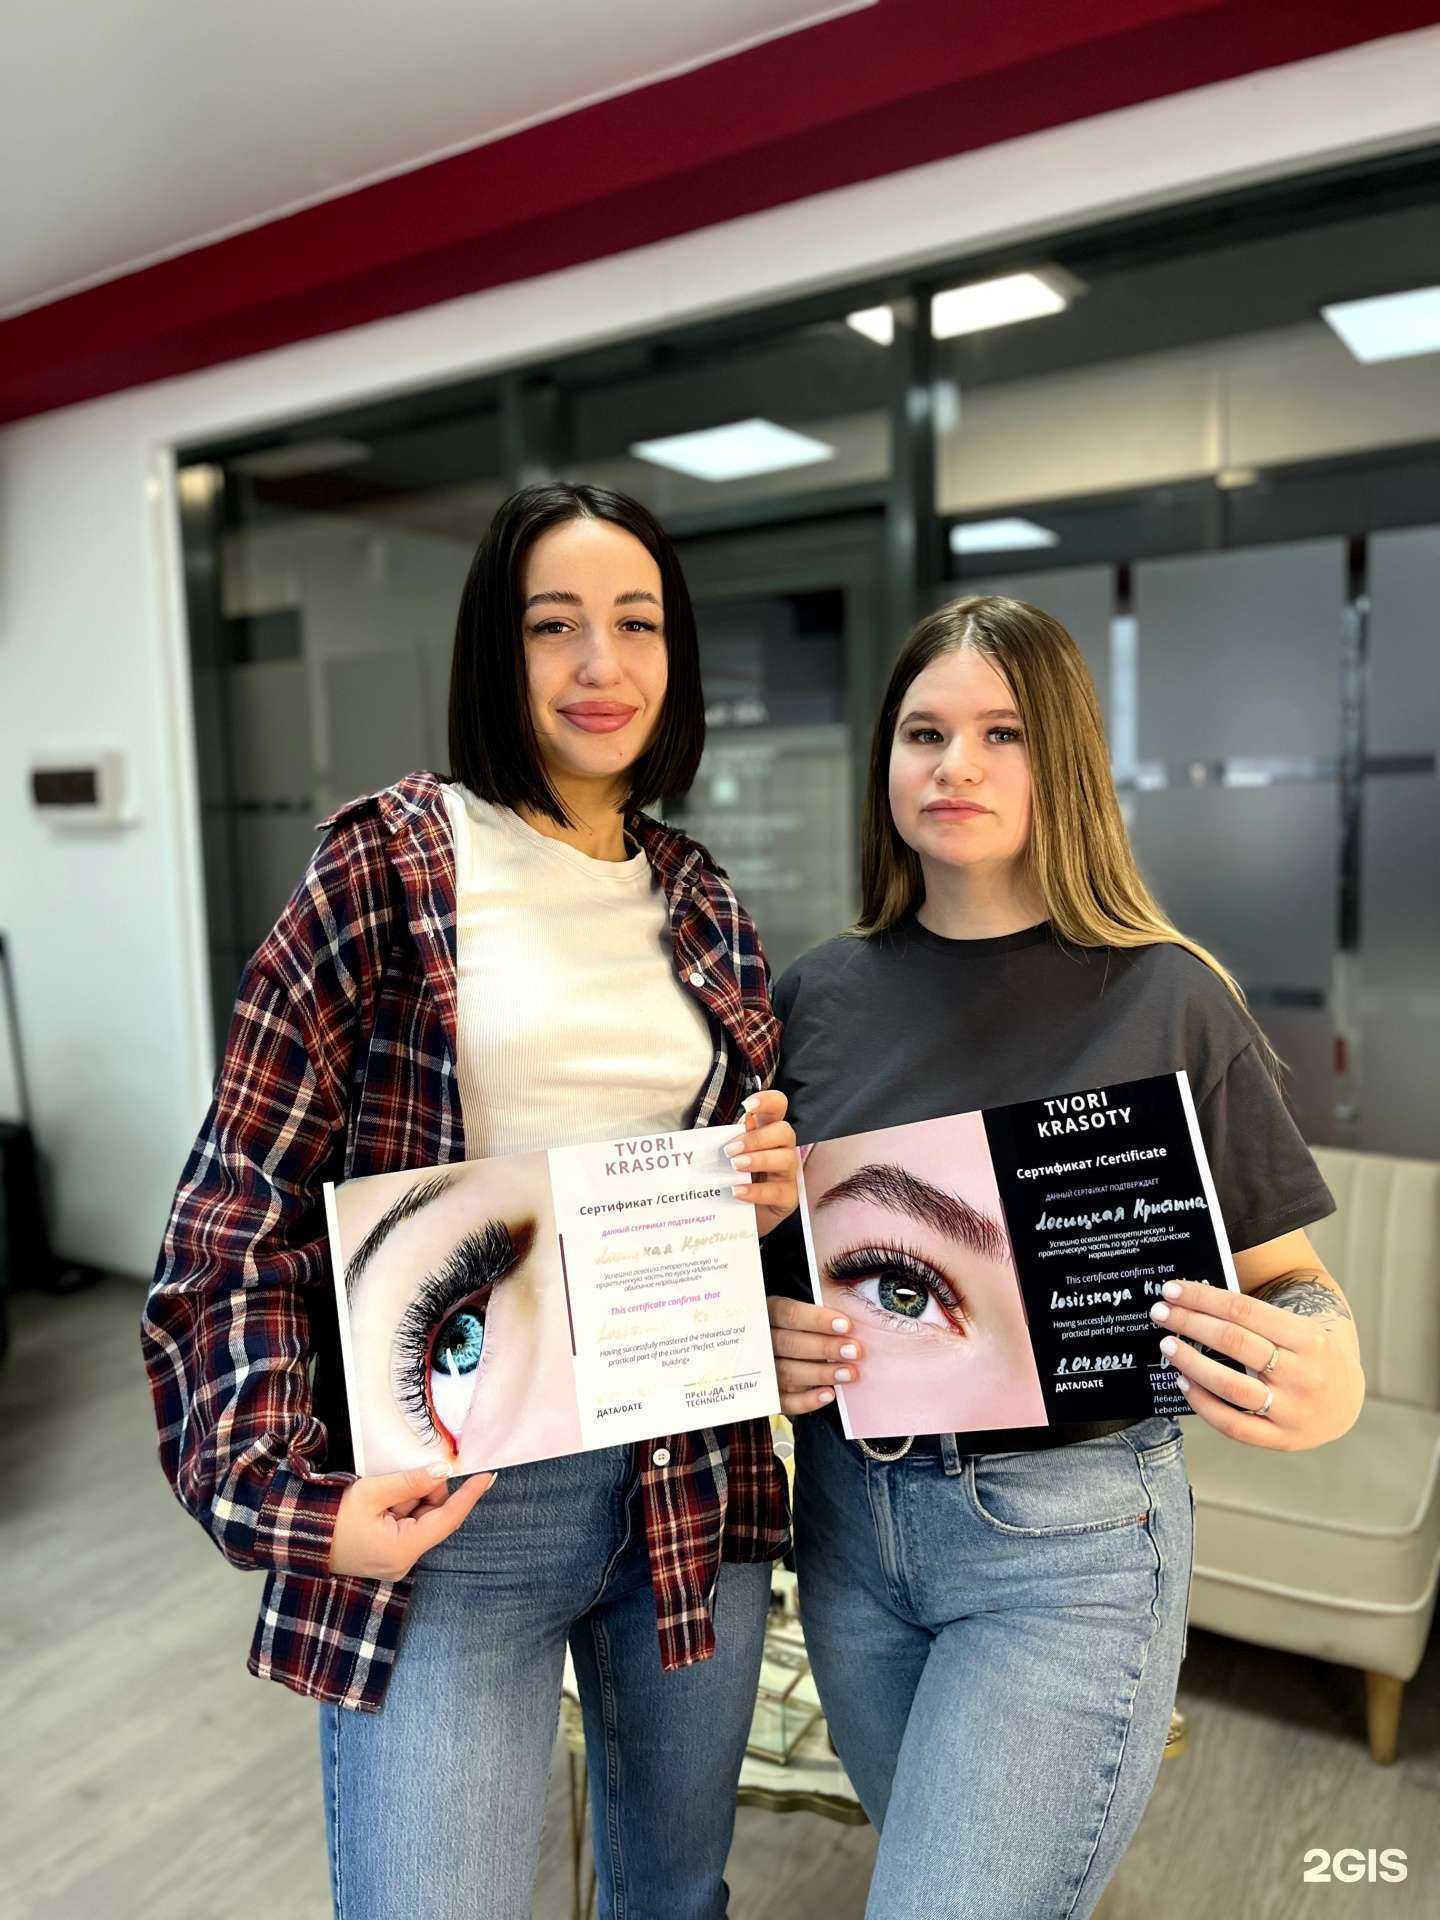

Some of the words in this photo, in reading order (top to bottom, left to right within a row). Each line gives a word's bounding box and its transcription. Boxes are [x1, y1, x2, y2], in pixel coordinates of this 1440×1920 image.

[1044, 1091, 1108, 1116] TVORI
[1037, 1107, 1131, 1138] KRASOTY
[615, 1137, 674, 1157] TVORI
[605, 1151, 694, 1176] KRASOTY
[1016, 1159, 1092, 1180] Сертификат
[1096, 1147, 1167, 1167] /Certificate
[1045, 1190, 1073, 1202] ДАННЫЙ
[1110, 1178, 1159, 1192] ПОДТВЕРЖДАЕТ
[579, 1198, 653, 1216] Сертификат
[656, 1187, 721, 1205] /Certificate
[1133, 1196, 1208, 1223] Кристина
[667, 1214, 717, 1228] ПОДТВЕРЖДАЕТ
[1049, 1238, 1080, 1248] Успешно
[1109, 1226, 1166, 1240] теоретическую
[1038, 1246, 1088, 1259] практическую
[1088, 1242, 1111, 1251] часть
[1121, 1238, 1140, 1248] курсу
[1065, 1274, 1081, 1285] This
[1082, 1271, 1119, 1284] certificate
[1120, 1267, 1155, 1279] confirms
[1158, 1263, 1175, 1274] that
[610, 1306, 626, 1316] This
[627, 1300, 667, 1313] certificate
[667, 1294, 701, 1307] confirms
[704, 1290, 721, 1301] that
[1053, 1317, 1076, 1329] Having
[1076, 1313, 1115, 1327] successfully
[1115, 1310, 1148, 1323] mastered
[1061, 1329, 1090, 1341] practical
[1091, 1327, 1106, 1338] part
[1106, 1326, 1114, 1336] of
[1114, 1325, 1126, 1334] the
[1126, 1323, 1149, 1333] course
[636, 1353, 650, 1364] part
[658, 1349, 669, 1358] the
[1055, 1379, 1105, 1393] ДАТА/DATE
[596, 1402, 643, 1418] ДАТА/DATE
